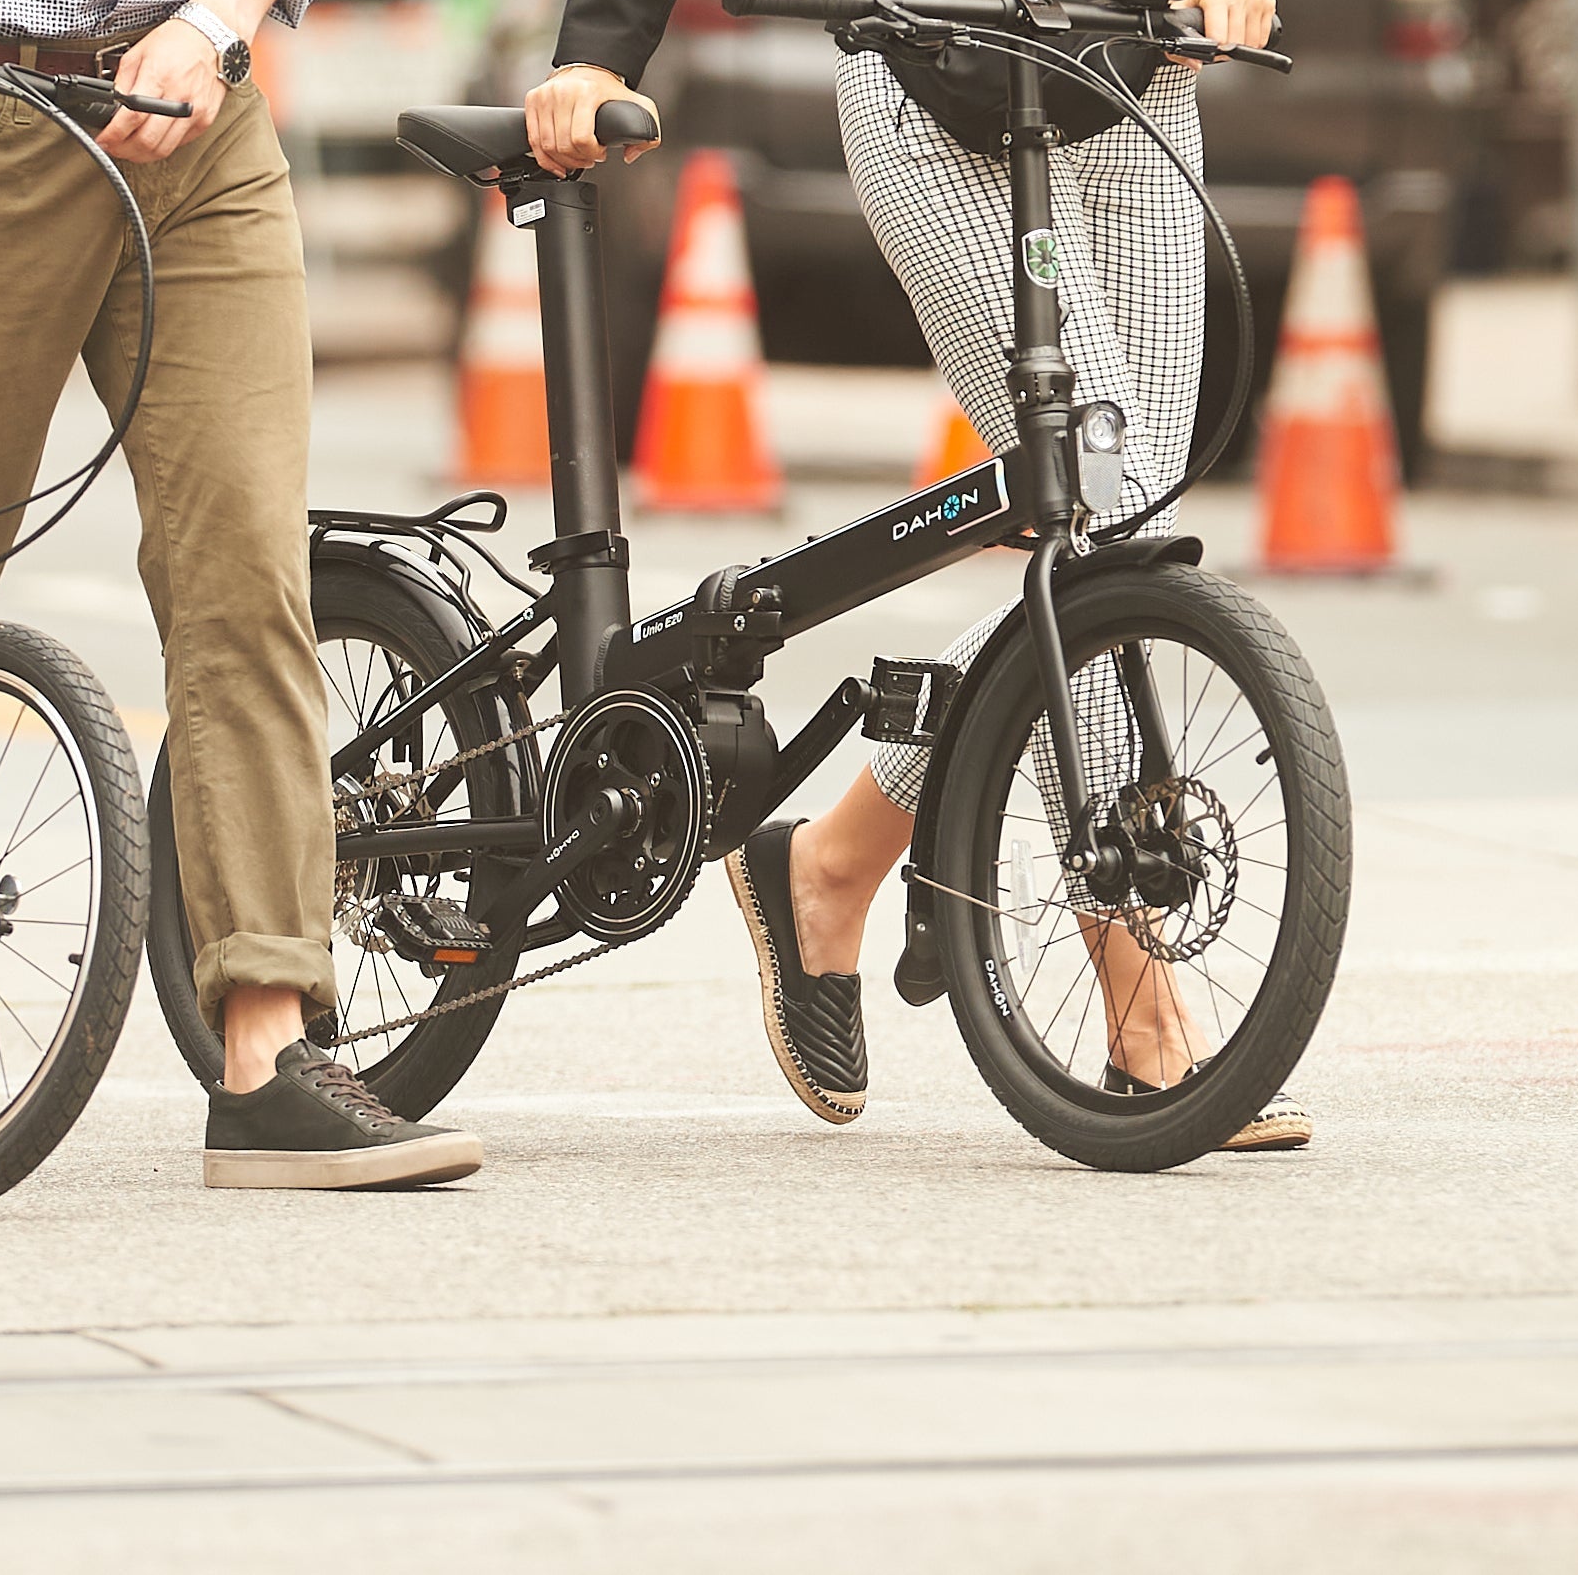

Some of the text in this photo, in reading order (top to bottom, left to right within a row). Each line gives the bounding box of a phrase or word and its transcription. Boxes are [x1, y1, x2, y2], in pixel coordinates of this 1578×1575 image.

[892, 488, 979, 541] DAHON
[664, 611, 684, 629] E20
[546, 829, 581, 864] DAHON
[984, 958, 1011, 1017] DAHON
